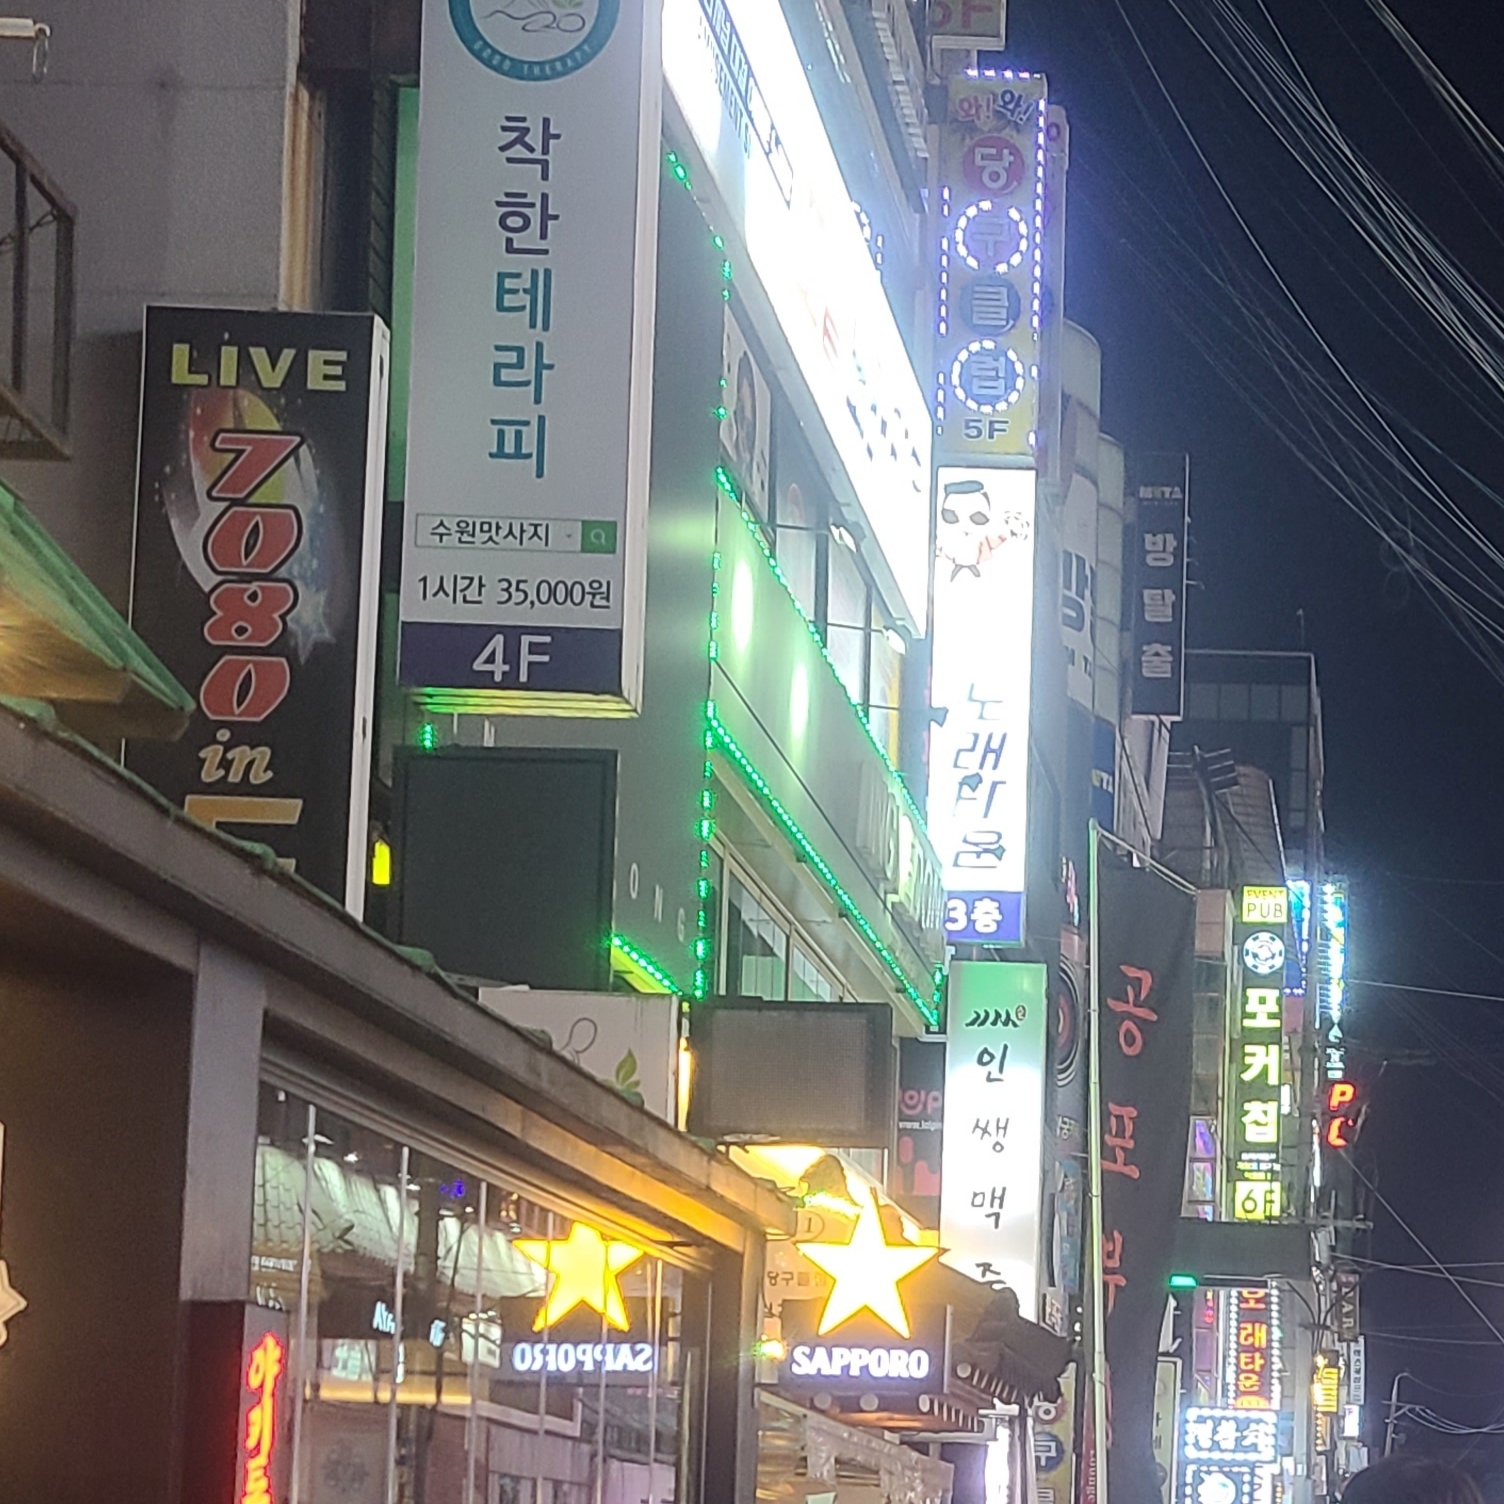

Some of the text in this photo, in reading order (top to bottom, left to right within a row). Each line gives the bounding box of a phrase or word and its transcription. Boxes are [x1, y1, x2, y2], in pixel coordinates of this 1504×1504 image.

[522, 44, 592, 75] THERAPY
[488, 115, 562, 478] 착한테라피
[171, 343, 348, 391] LIVE
[963, 418, 1010, 440] 5F
[429, 521, 550, 547] 수원맛사지
[200, 429, 304, 722] 7080
[418, 576, 612, 610] 1시간 35,000원
[1141, 533, 1177, 677] 방탈출
[472, 634, 552, 683] 4F
[199, 729, 273, 784] in
[952, 683, 1007, 869] 노래타운
[1247, 889, 1285, 900] EVENT
[1247, 902, 1284, 918] PUB
[944, 897, 1003, 934] 3층
[1327, 1081, 1356, 1148] PC
[1242, 1189, 1275, 1217] 6F
[767, 1271, 828, 1287] 당구
[791, 1345, 930, 1379] SAPPORO
